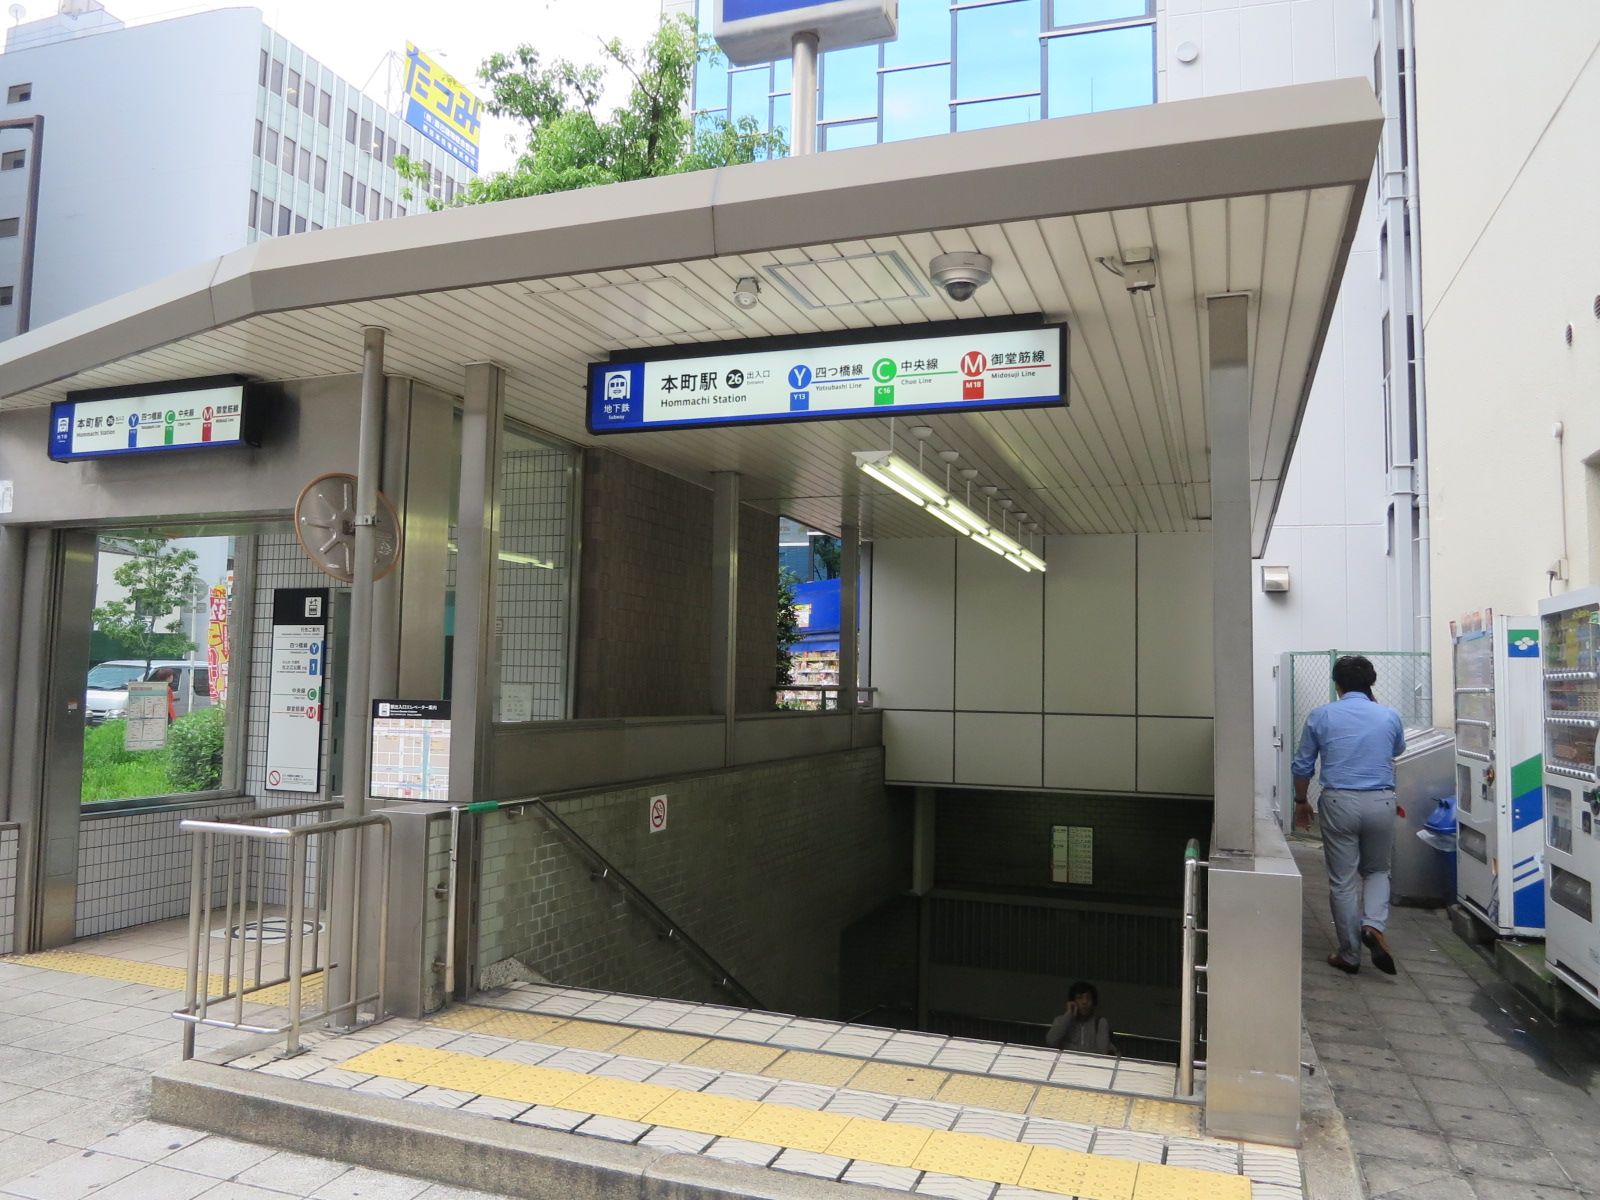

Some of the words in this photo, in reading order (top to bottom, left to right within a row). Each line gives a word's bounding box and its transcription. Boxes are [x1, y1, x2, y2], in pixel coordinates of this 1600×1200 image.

[405, 46, 480, 135] たつみ
[901, 358, 938, 372] 中央線
[964, 355, 983, 373] M
[991, 350, 1045, 366] 御堂筋線
[746, 370, 771, 380] 出入口
[793, 368, 806, 386] Y
[815, 364, 863, 378] 四つ橋線
[876, 361, 891, 380] C
[991, 371, 1020, 380] Midosuji
[1022, 370, 1036, 378] Line
[661, 372, 718, 394] 本町駅
[727, 372, 743, 386] 26
[815, 383, 847, 391] Yotsubashi
[661, 395, 710, 408] Hommachi
[713, 394, 747, 405] Station
[203, 408, 213, 420] M
[603, 403, 630, 414] 地下鉄
[77, 416, 102, 429] 本町駅
[165, 412, 174, 422] C
